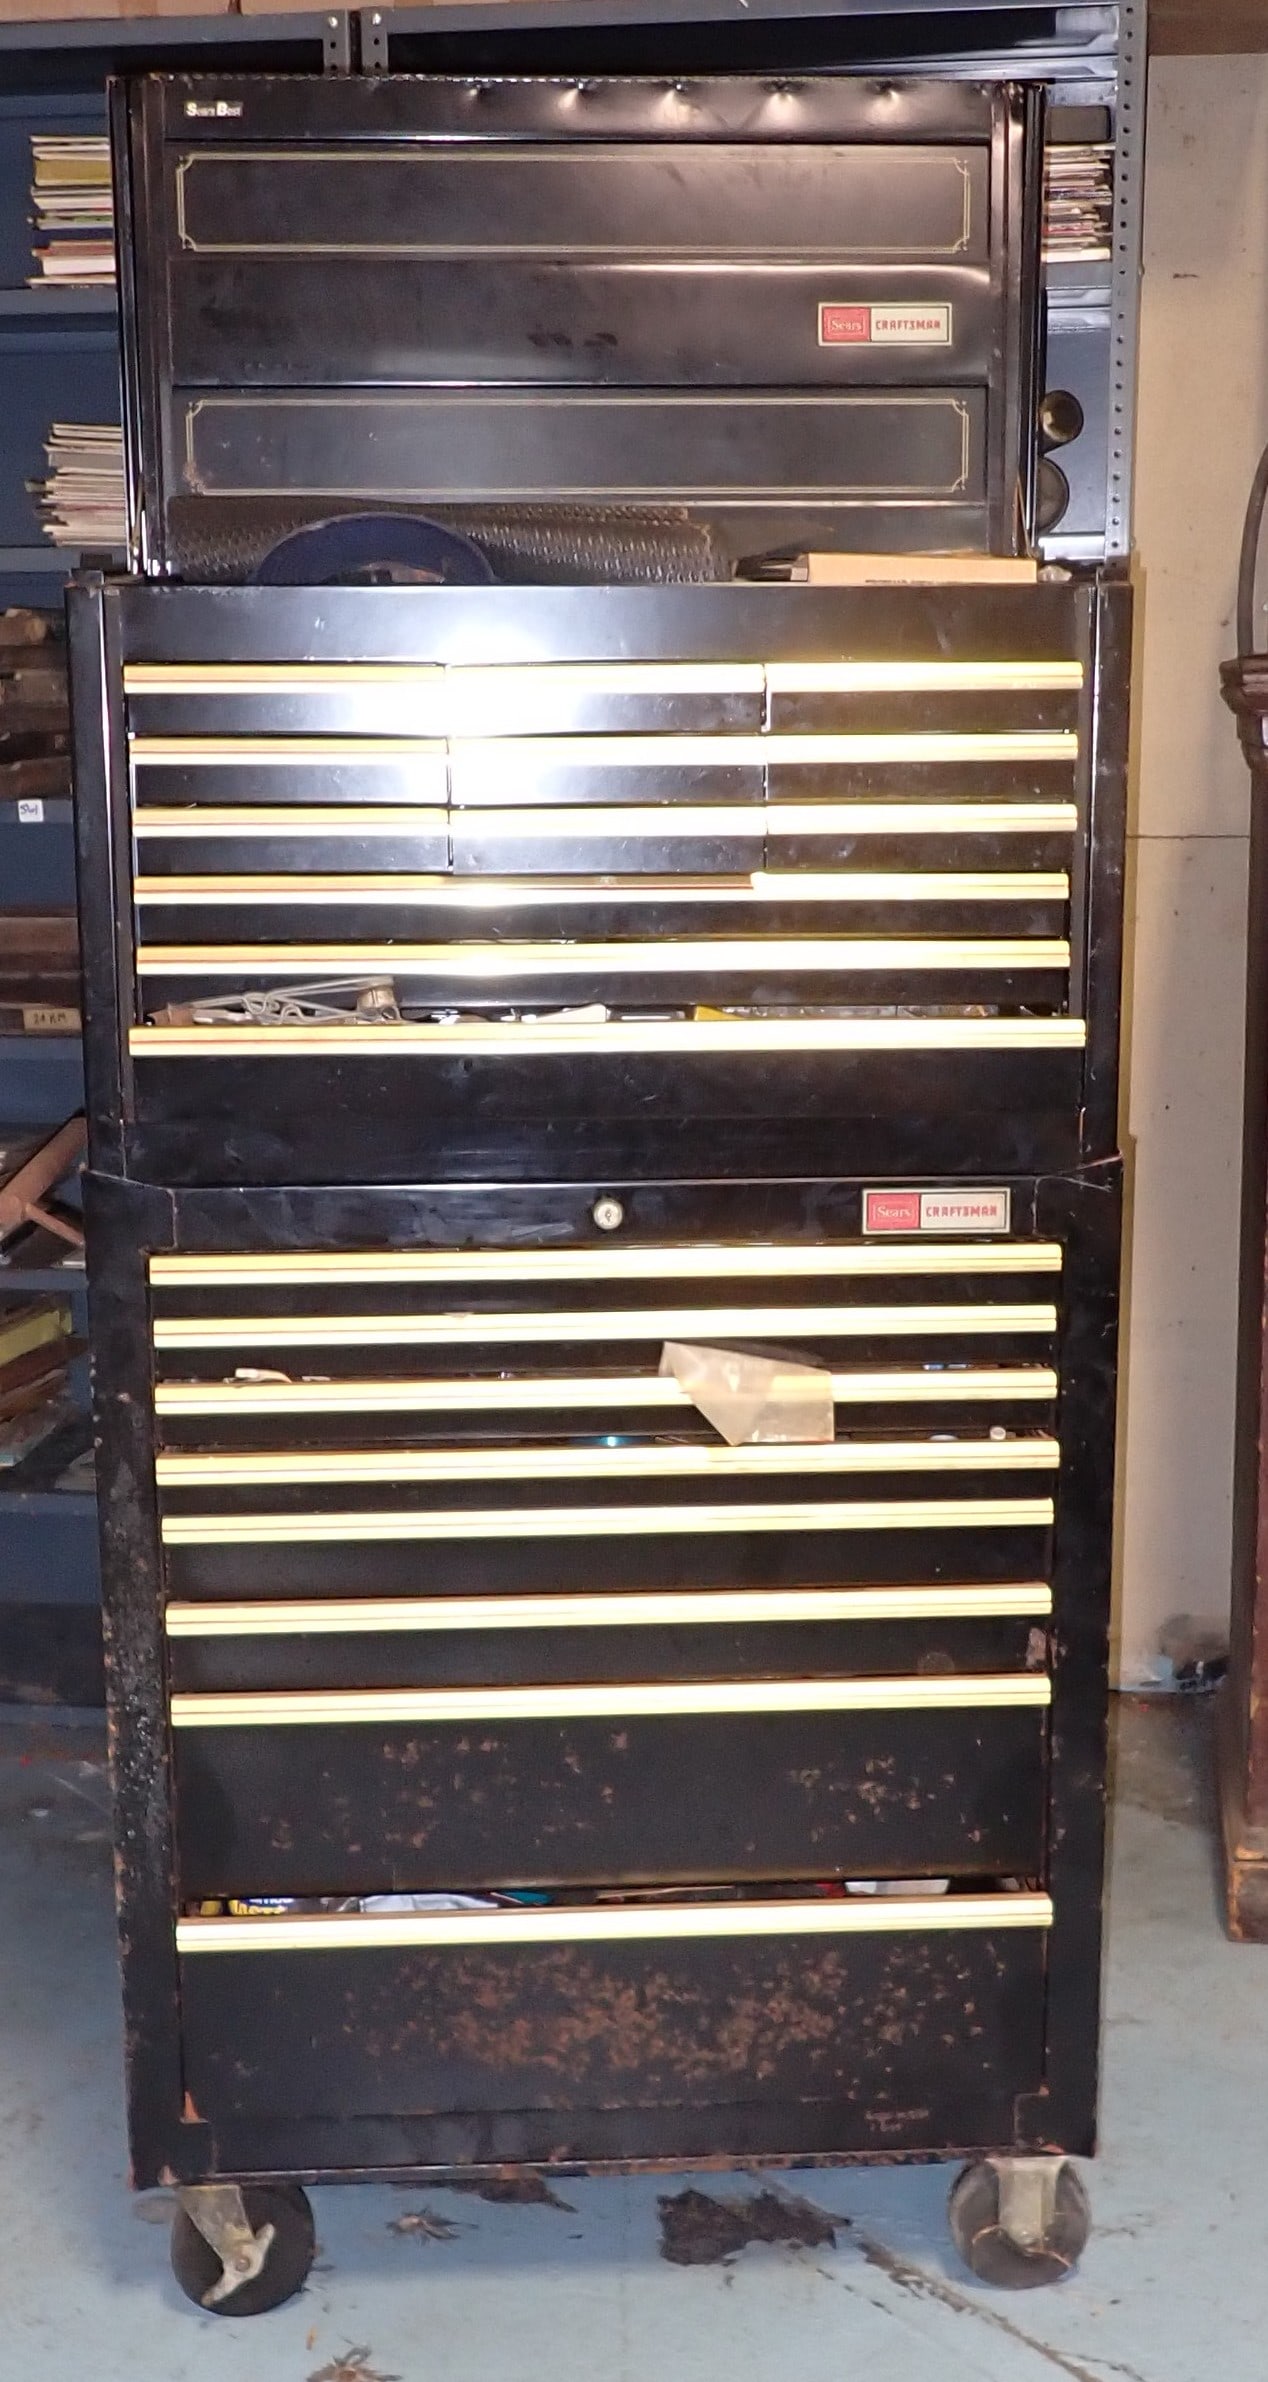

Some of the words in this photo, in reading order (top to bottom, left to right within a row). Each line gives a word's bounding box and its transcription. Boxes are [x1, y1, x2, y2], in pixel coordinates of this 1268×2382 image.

[831, 318, 863, 331] Sears
[875, 319, 941, 331] CRAFTSMAN
[877, 1205, 913, 1218] Sears
[925, 1204, 998, 1218] CRAFTSMAN
